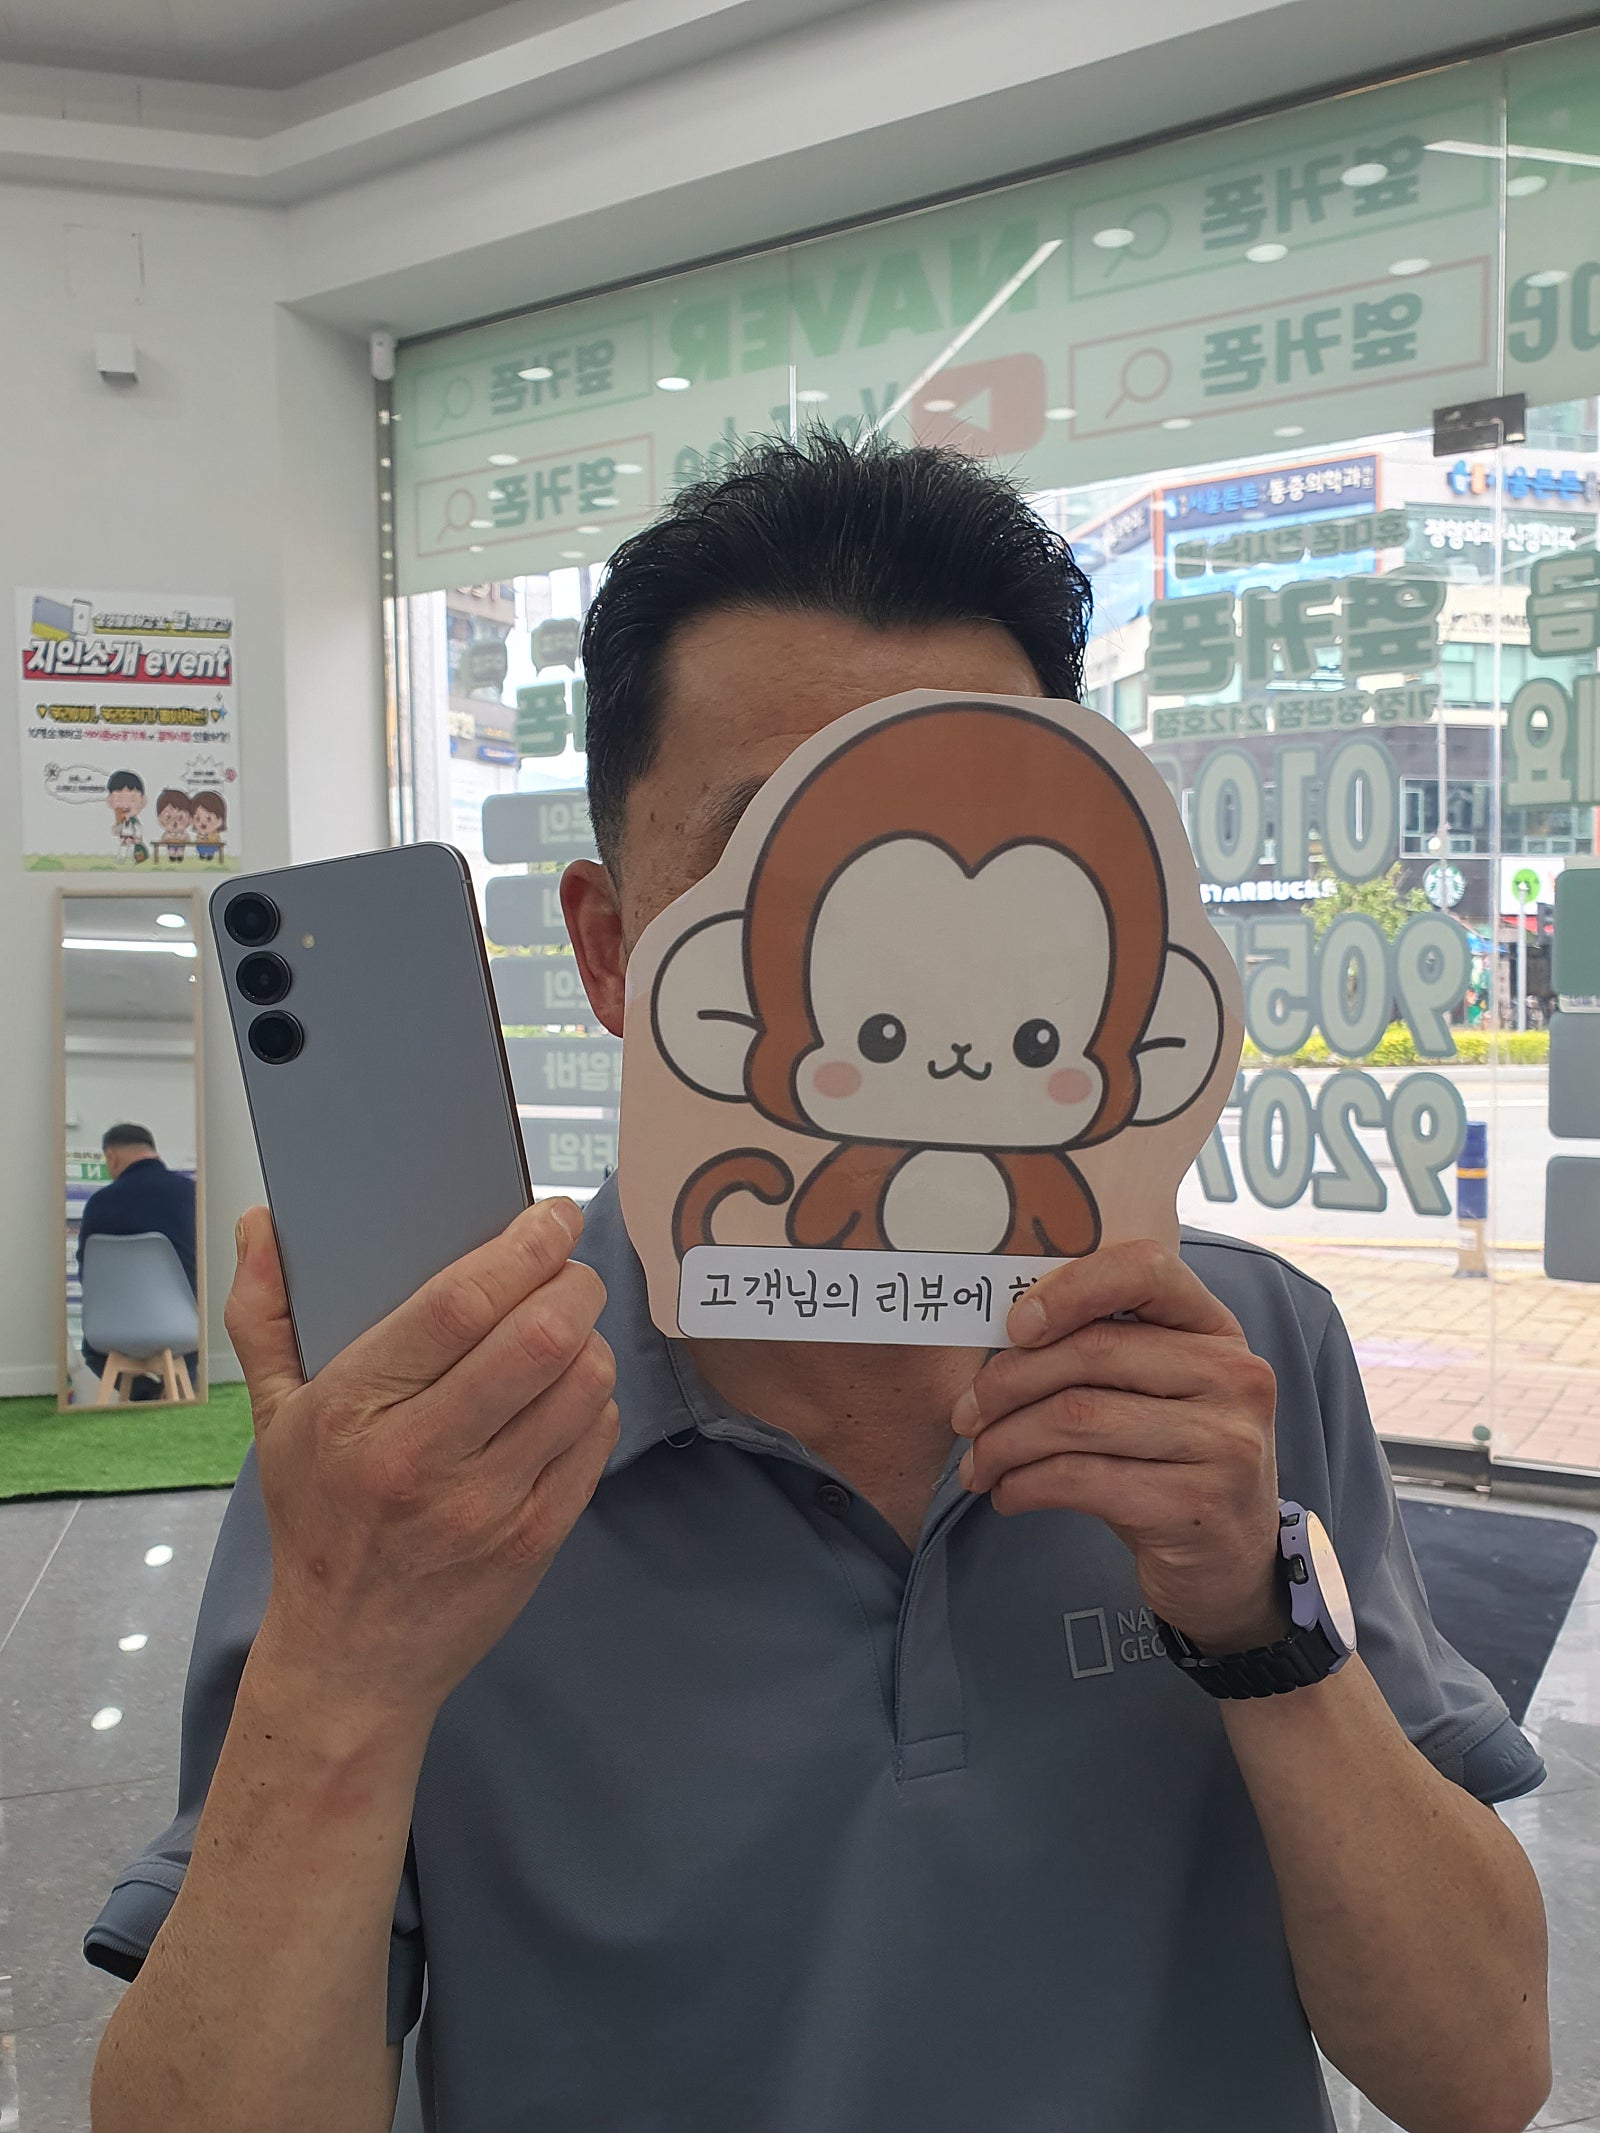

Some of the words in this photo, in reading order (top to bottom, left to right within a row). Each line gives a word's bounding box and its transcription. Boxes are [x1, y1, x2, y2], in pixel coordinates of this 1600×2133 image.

[27, 639, 142, 677] 지인소개
[144, 644, 231, 679] event
[1199, 879, 1338, 904] STARBUCKS
[700, 1268, 858, 1318] 고객님의
[875, 1272, 993, 1322] 리뷰에
[1117, 1606, 1153, 1635] NA
